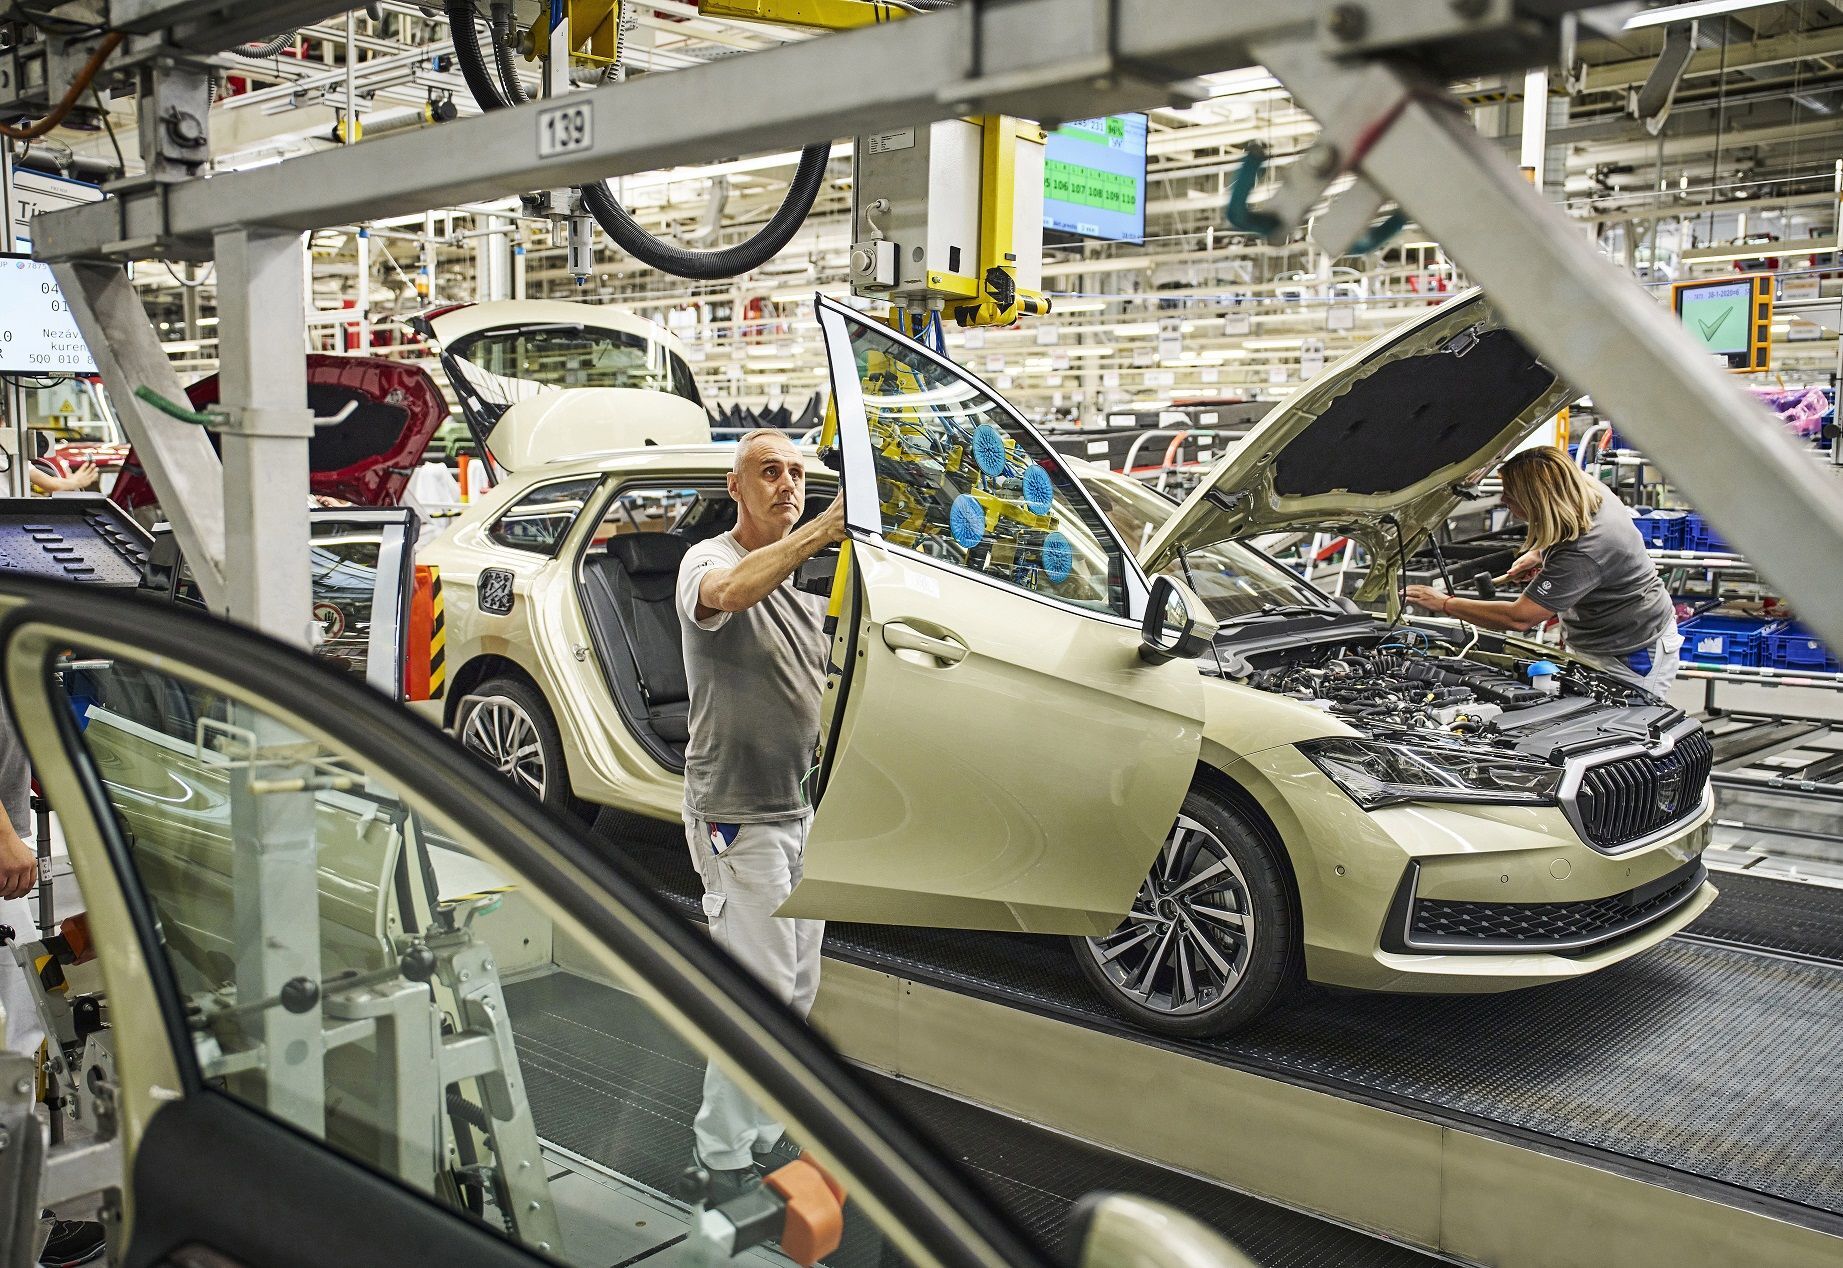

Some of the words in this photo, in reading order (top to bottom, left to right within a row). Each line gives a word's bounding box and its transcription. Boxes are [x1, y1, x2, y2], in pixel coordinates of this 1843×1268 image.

[547, 109, 585, 148] 139
[1053, 179, 1069, 191] 106
[1071, 183, 1086, 194] 107
[1089, 186, 1104, 198] 108
[1106, 190, 1120, 202] 109
[1122, 193, 1136, 204] 110
